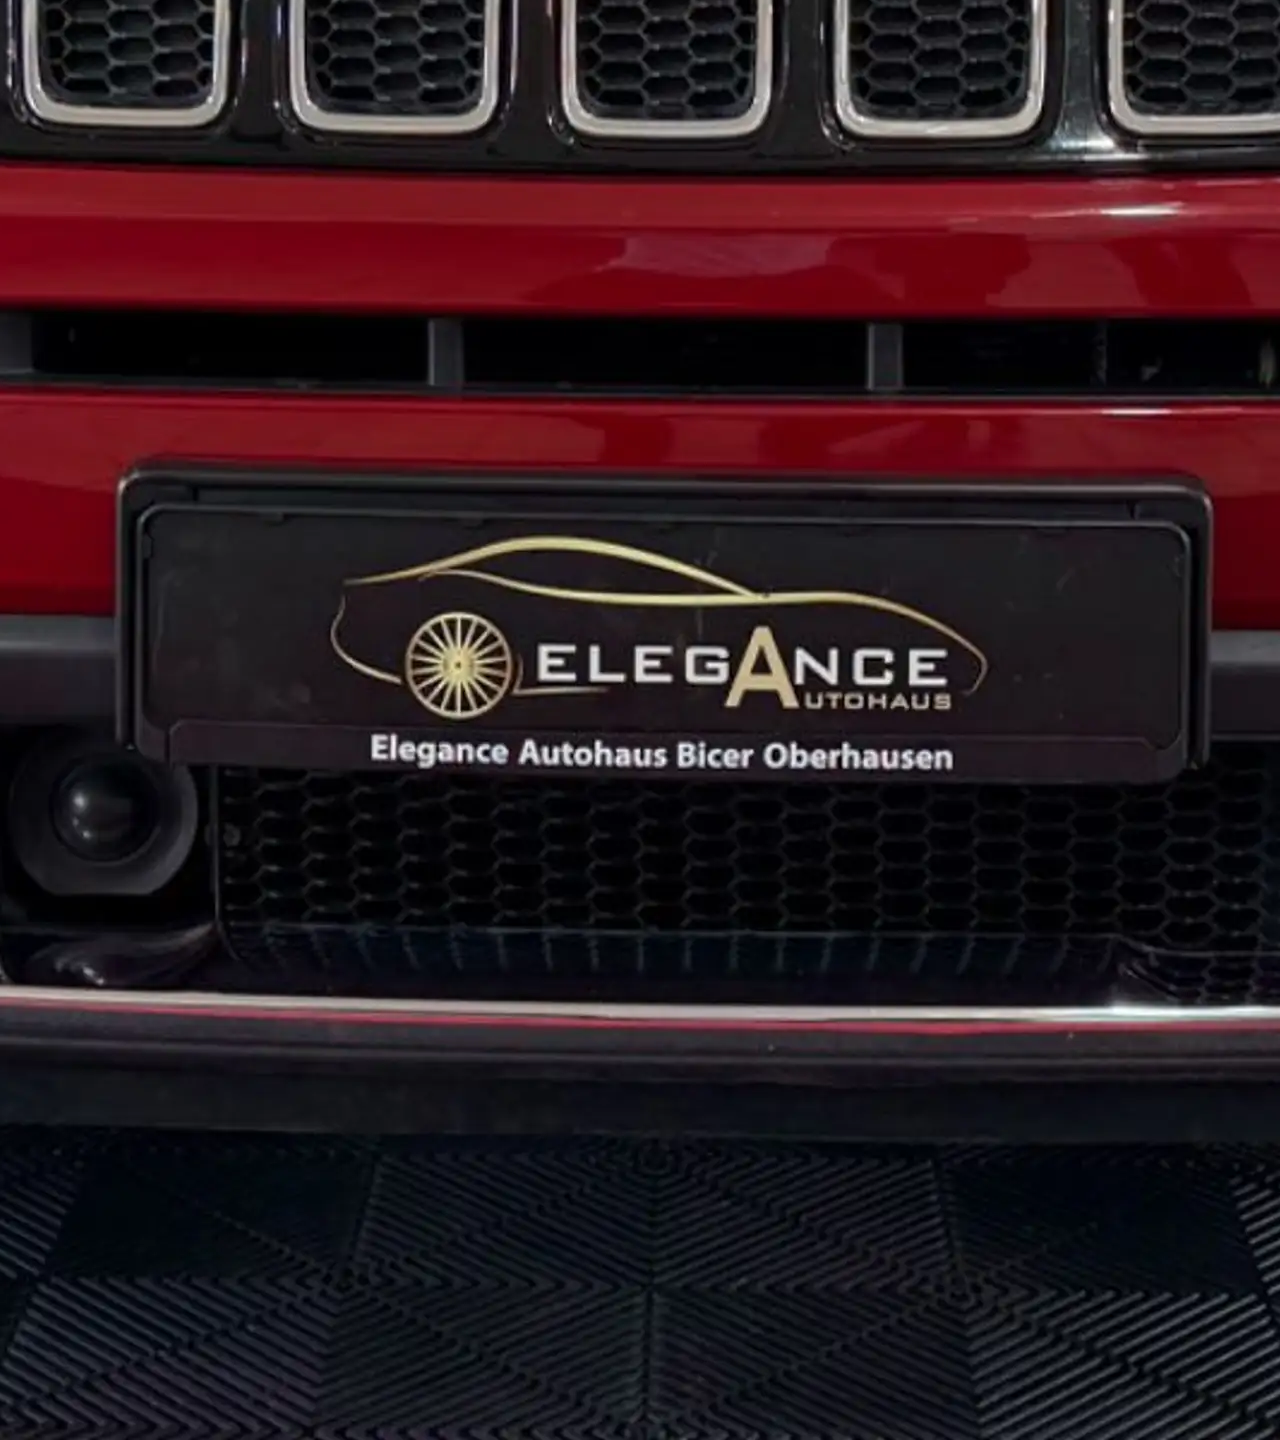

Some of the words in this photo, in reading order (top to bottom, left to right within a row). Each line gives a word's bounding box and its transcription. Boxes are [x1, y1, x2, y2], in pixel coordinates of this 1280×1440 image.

[537, 625, 949, 708] ELEGANCE
[370, 733, 510, 769] Elegance
[519, 738, 668, 768] Autohaus
[677, 741, 755, 769] Bicer
[763, 741, 954, 770] Oberhausen
